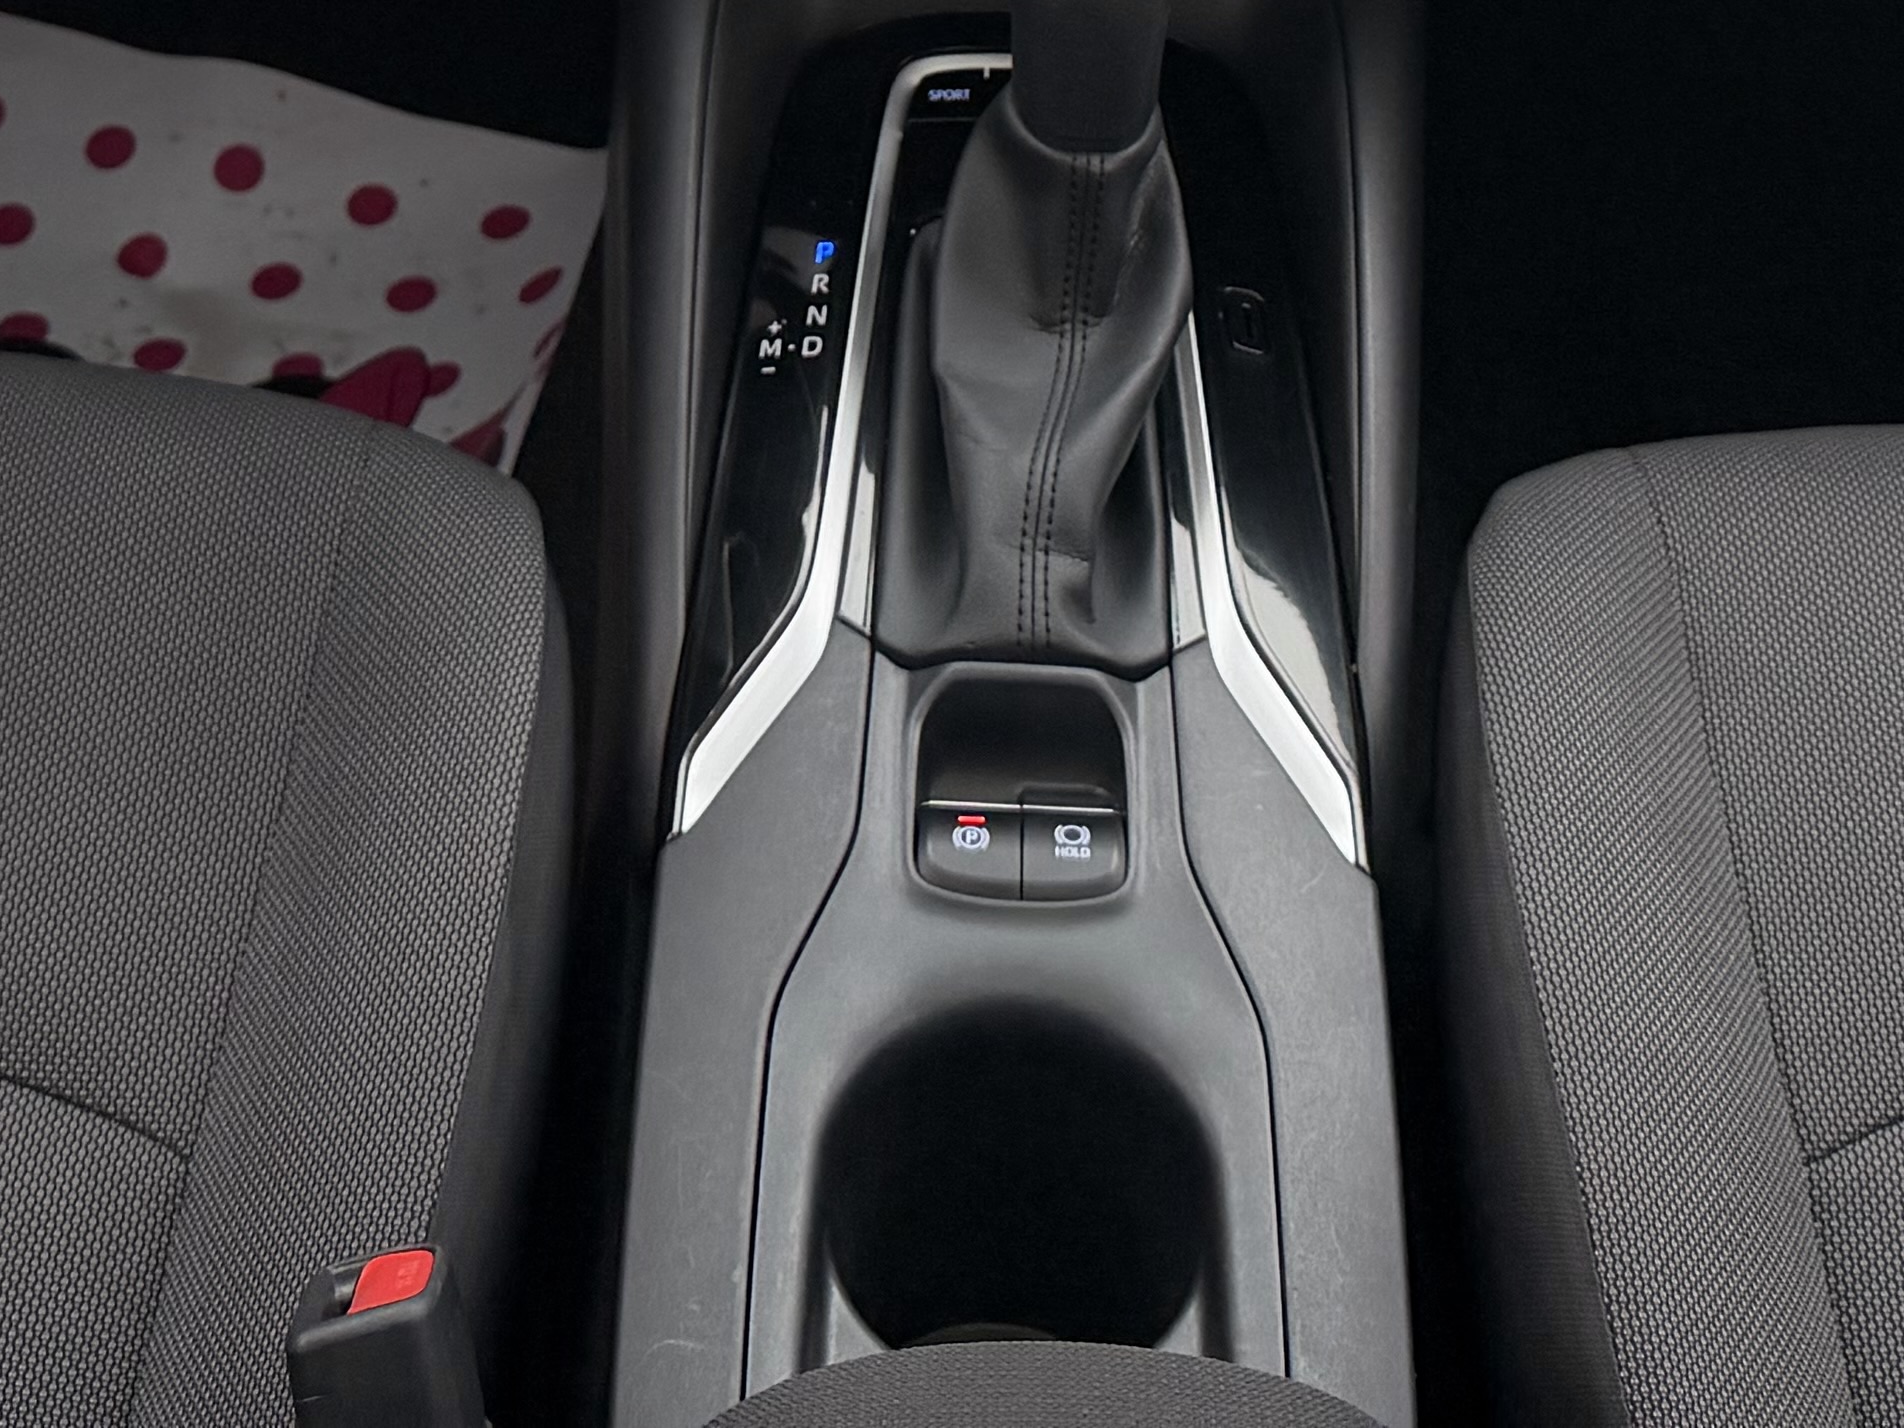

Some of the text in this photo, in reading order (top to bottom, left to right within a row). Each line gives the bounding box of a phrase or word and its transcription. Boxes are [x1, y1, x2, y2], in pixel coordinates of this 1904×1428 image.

[927, 88, 971, 101] SPORT
[814, 241, 835, 264] P
[811, 273, 830, 294] R
[806, 305, 828, 326] N
[758, 335, 823, 359] M D
[1054, 845, 1091, 858] HOLD
